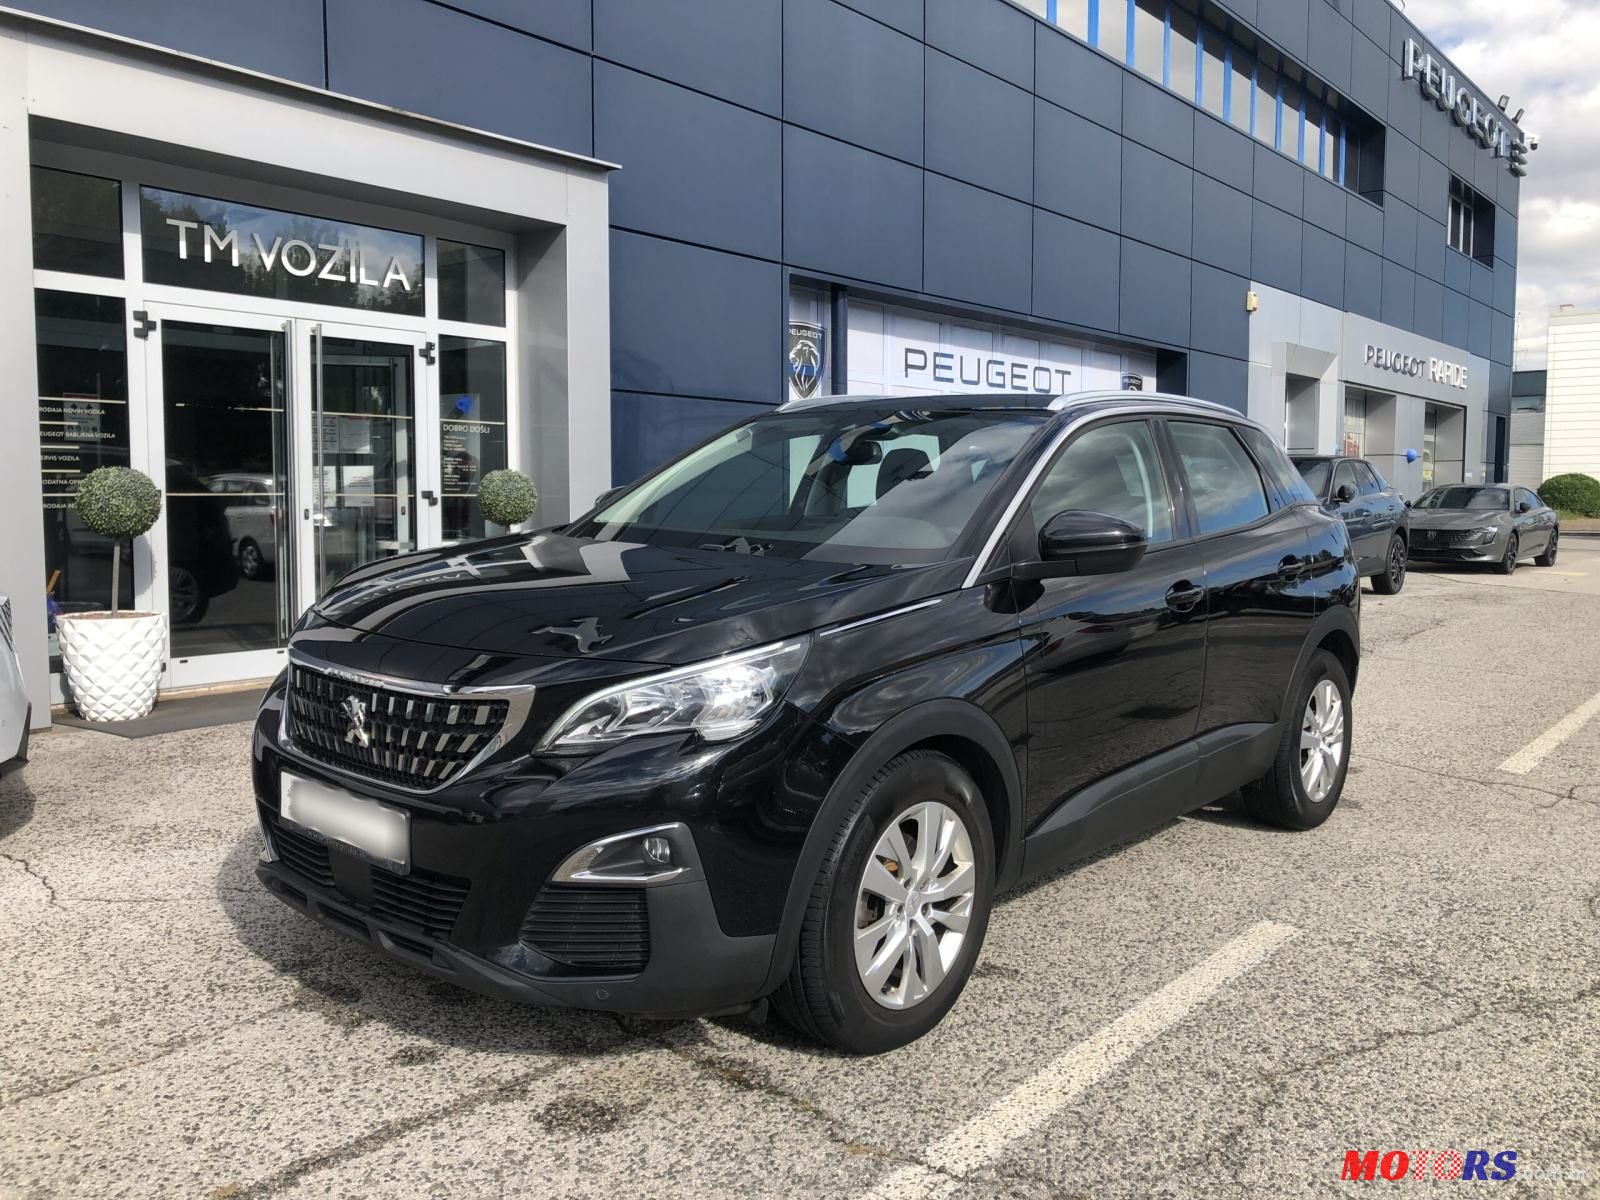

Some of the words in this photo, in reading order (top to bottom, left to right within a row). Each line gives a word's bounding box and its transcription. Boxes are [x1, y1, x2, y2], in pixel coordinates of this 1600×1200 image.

[1403, 38, 1509, 158] PEUGEOT
[166, 218, 239, 267] TM
[253, 232, 411, 291] VOZILA
[905, 347, 1072, 395] PEUGEOT
[1364, 344, 1426, 378] PEUGEOT
[1429, 356, 1468, 389] RAPIDE
[443, 424, 468, 432] DOBRO
